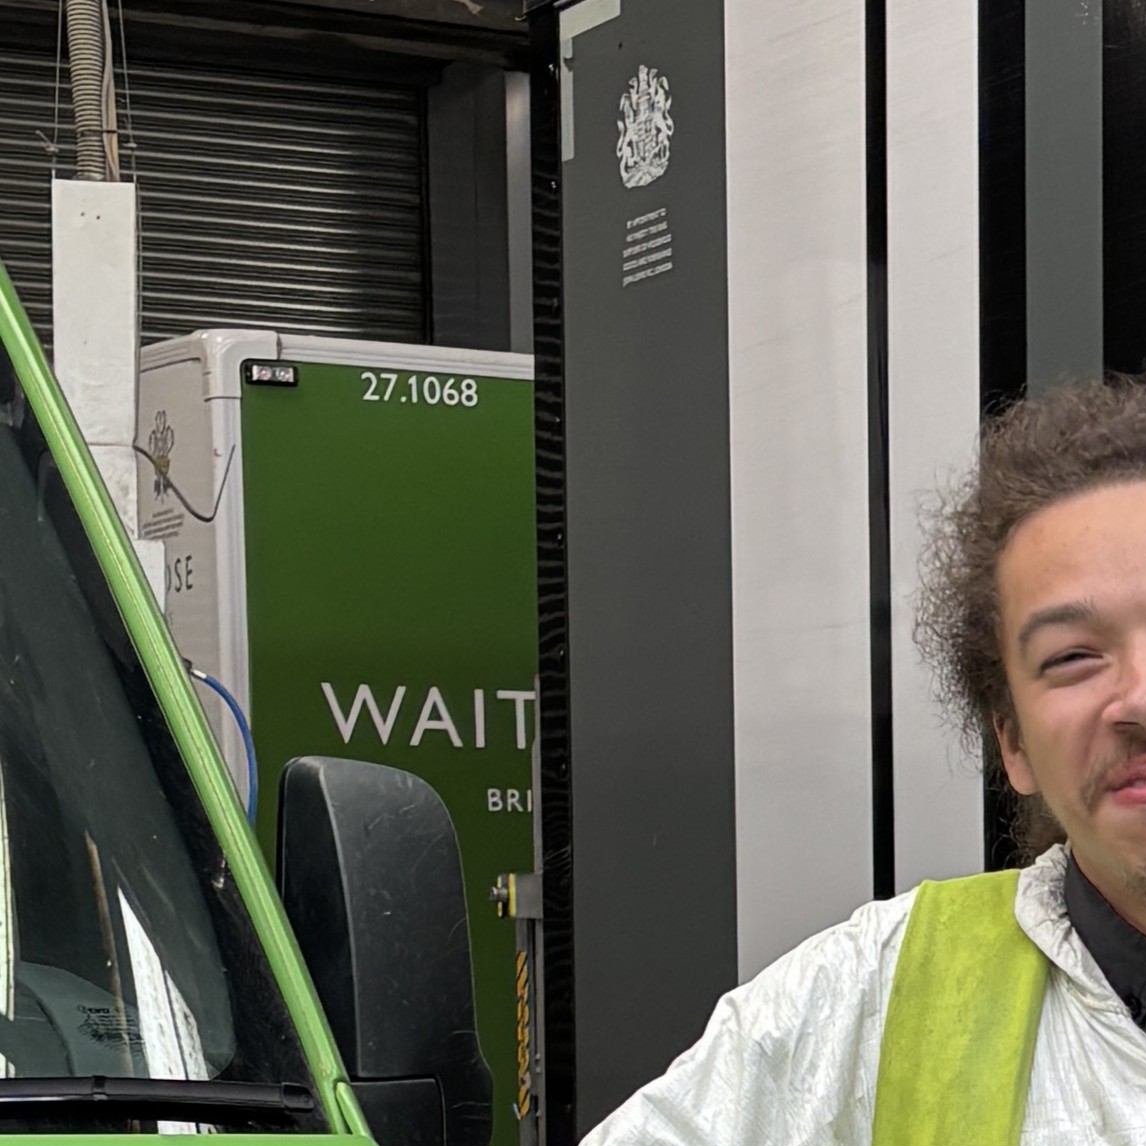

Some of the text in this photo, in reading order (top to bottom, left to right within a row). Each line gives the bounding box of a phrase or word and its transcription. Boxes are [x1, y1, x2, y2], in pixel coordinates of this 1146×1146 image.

[361, 371, 479, 407] 27.1068
[165, 554, 194, 593] SE
[320, 681, 536, 750] WAIT
[487, 787, 532, 813] BRI
